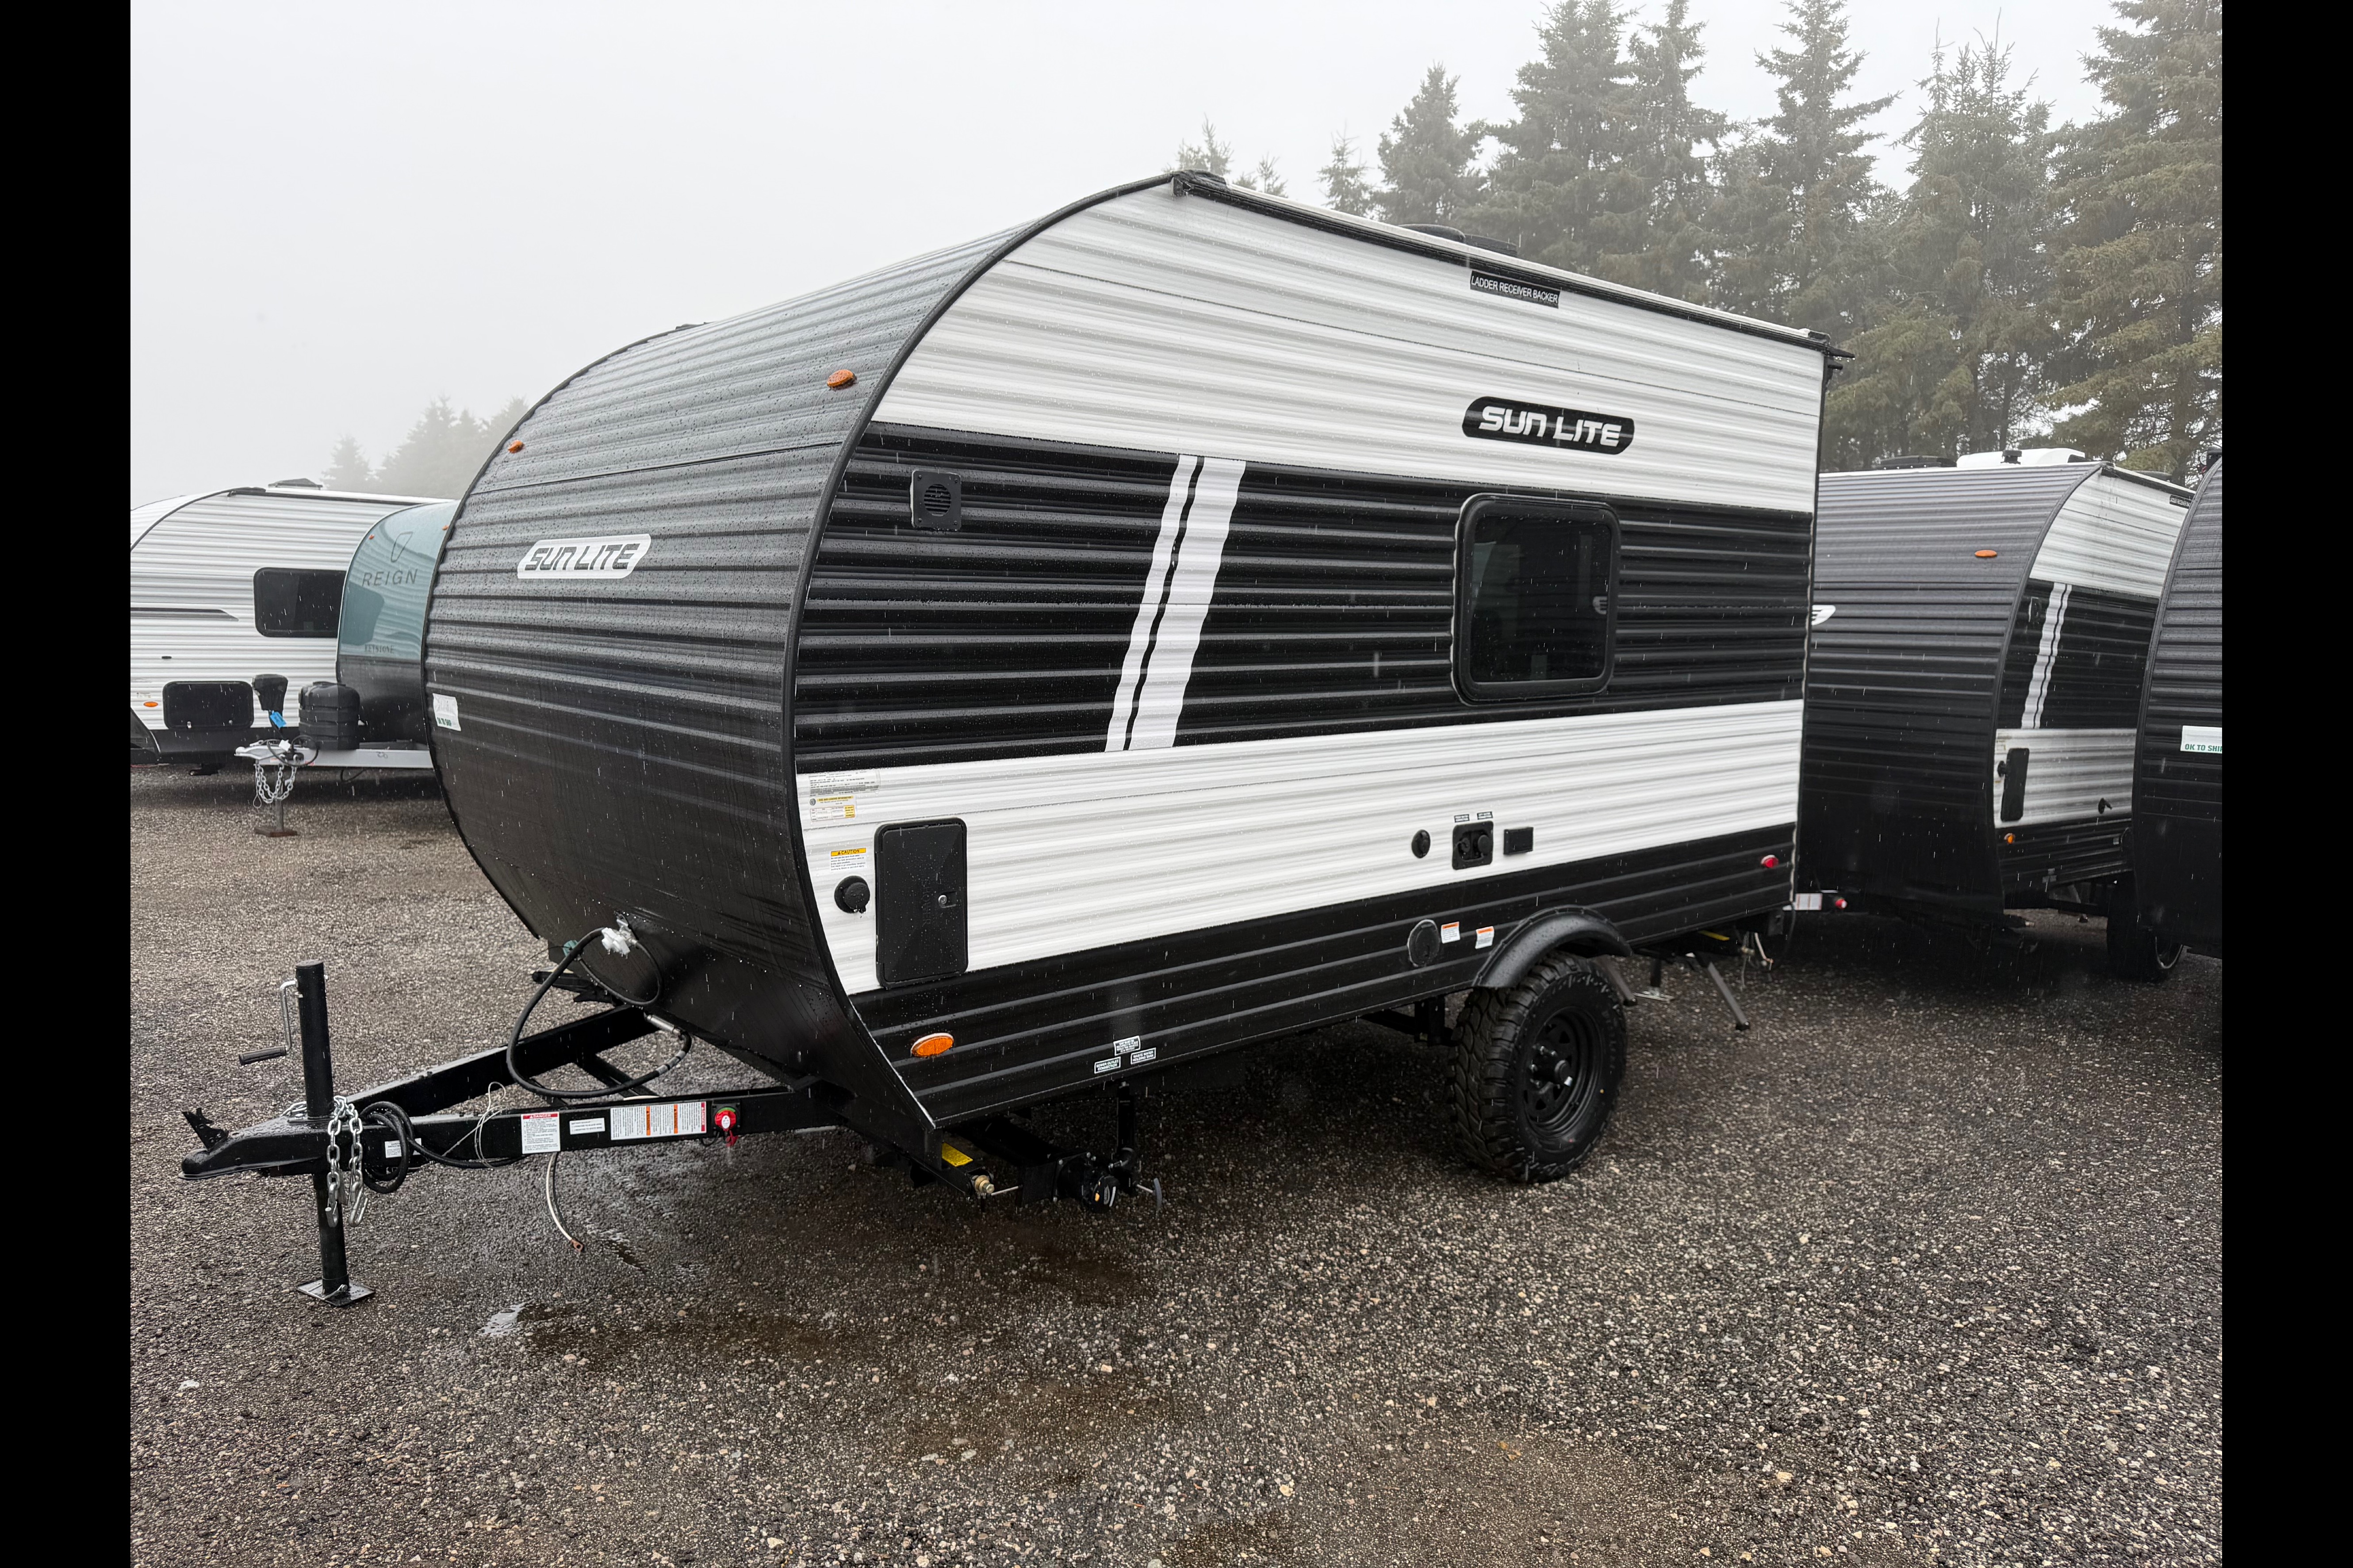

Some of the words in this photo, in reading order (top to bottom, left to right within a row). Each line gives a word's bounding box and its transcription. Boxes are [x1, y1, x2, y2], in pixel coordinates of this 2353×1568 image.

[1471, 275, 1498, 291] LADDER
[1499, 282, 1532, 297] RECEIVER
[1533, 290, 1558, 303] BACKER
[1479, 405, 1547, 437] SUN
[1552, 416, 1622, 447] LITE
[525, 546, 577, 571] SUN
[574, 543, 640, 570] LITE
[362, 568, 418, 587] REIGN
